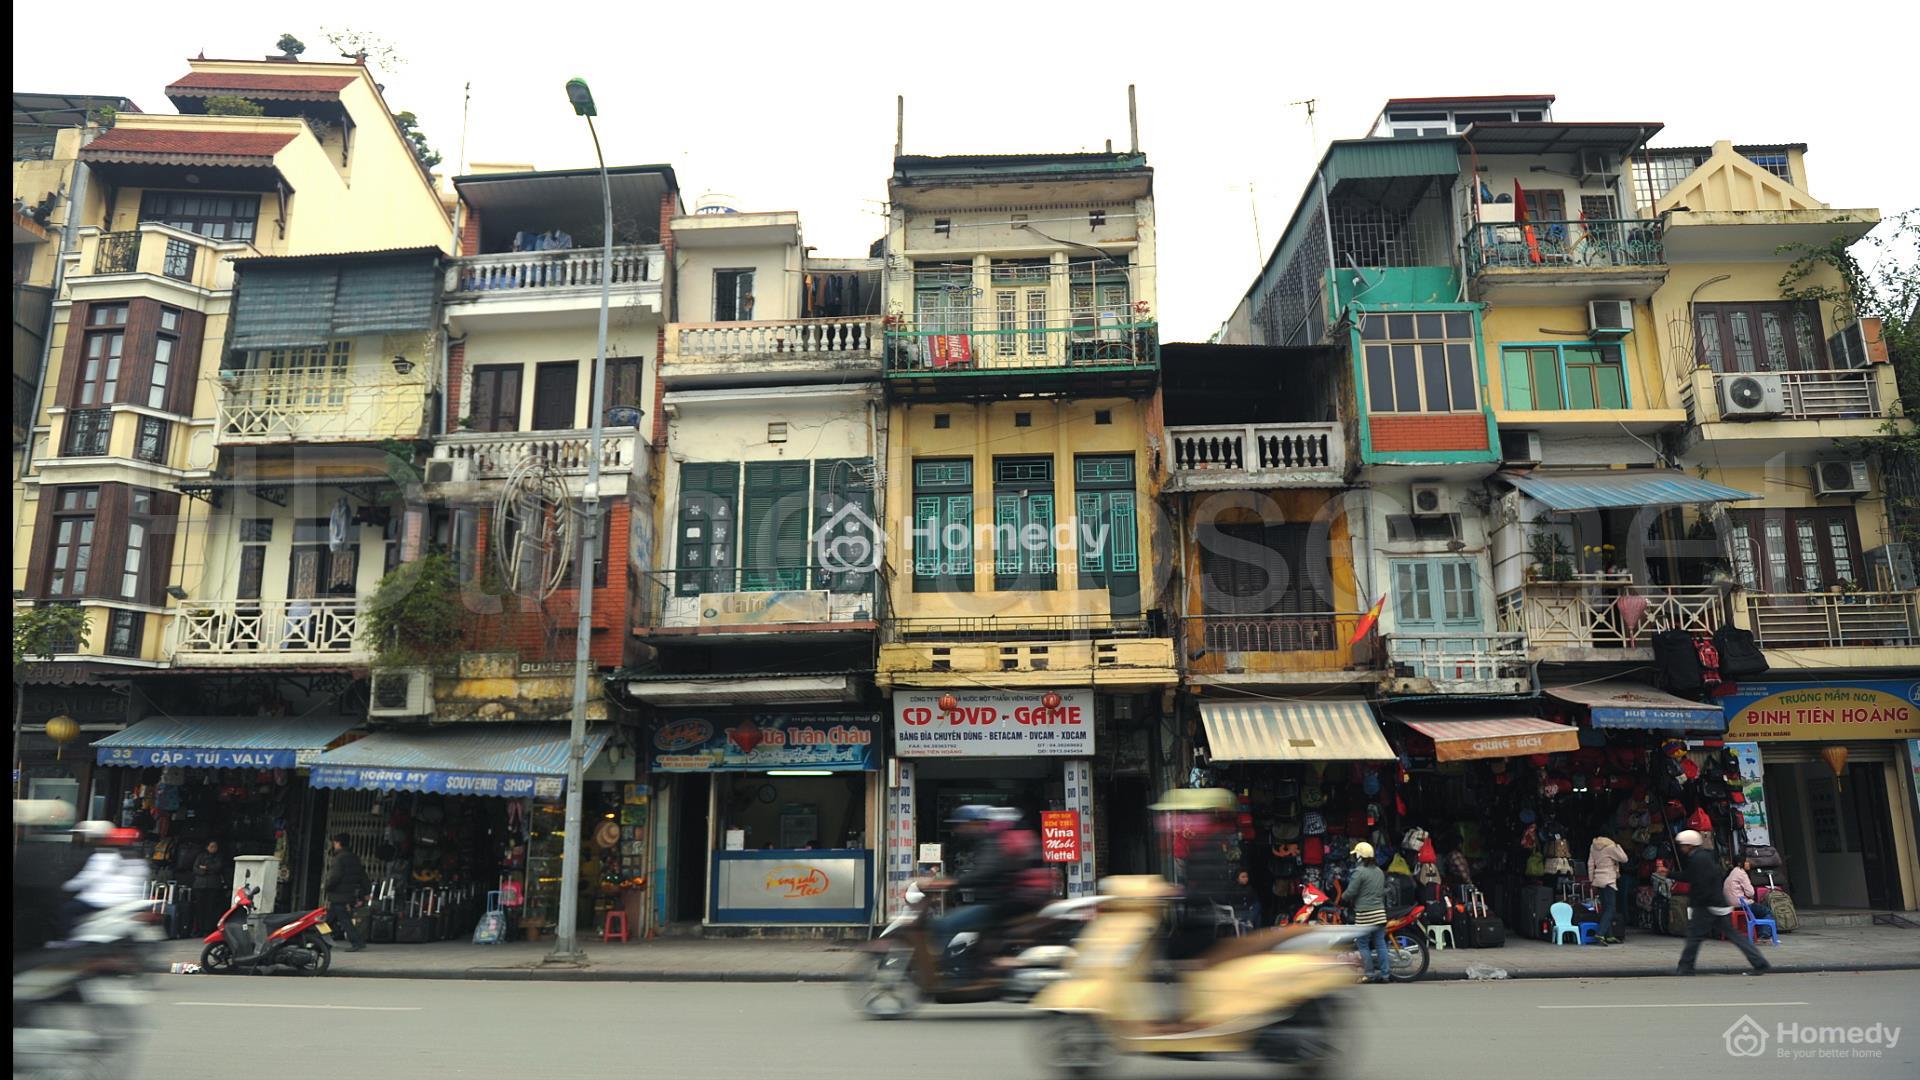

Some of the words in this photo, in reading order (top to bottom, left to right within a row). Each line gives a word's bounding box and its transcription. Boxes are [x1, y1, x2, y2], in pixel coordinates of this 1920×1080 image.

[1854, 692, 1876, 702] NON
[903, 707, 932, 725] CD
[951, 707, 997, 725] DVD
[1014, 706, 1082, 726] GAME
[1747, 710, 1791, 725] ĐINH
[1796, 706, 1835, 724] TIÊN
[1841, 703, 1909, 723] HOÀNG
[787, 725, 826, 745] Trân
[829, 724, 871, 745] Châu
[989, 731, 1022, 740] BETACAM
[1029, 731, 1054, 740] DVCAM
[112, 750, 132, 759] 33
[233, 753, 274, 765] VALY
[446, 775, 497, 791] SOUVENIR
[503, 777, 532, 792] SHOP
[1045, 828, 1074, 838] Vina
[1046, 838, 1075, 849] Mobi
[1045, 850, 1075, 861] Viettel
